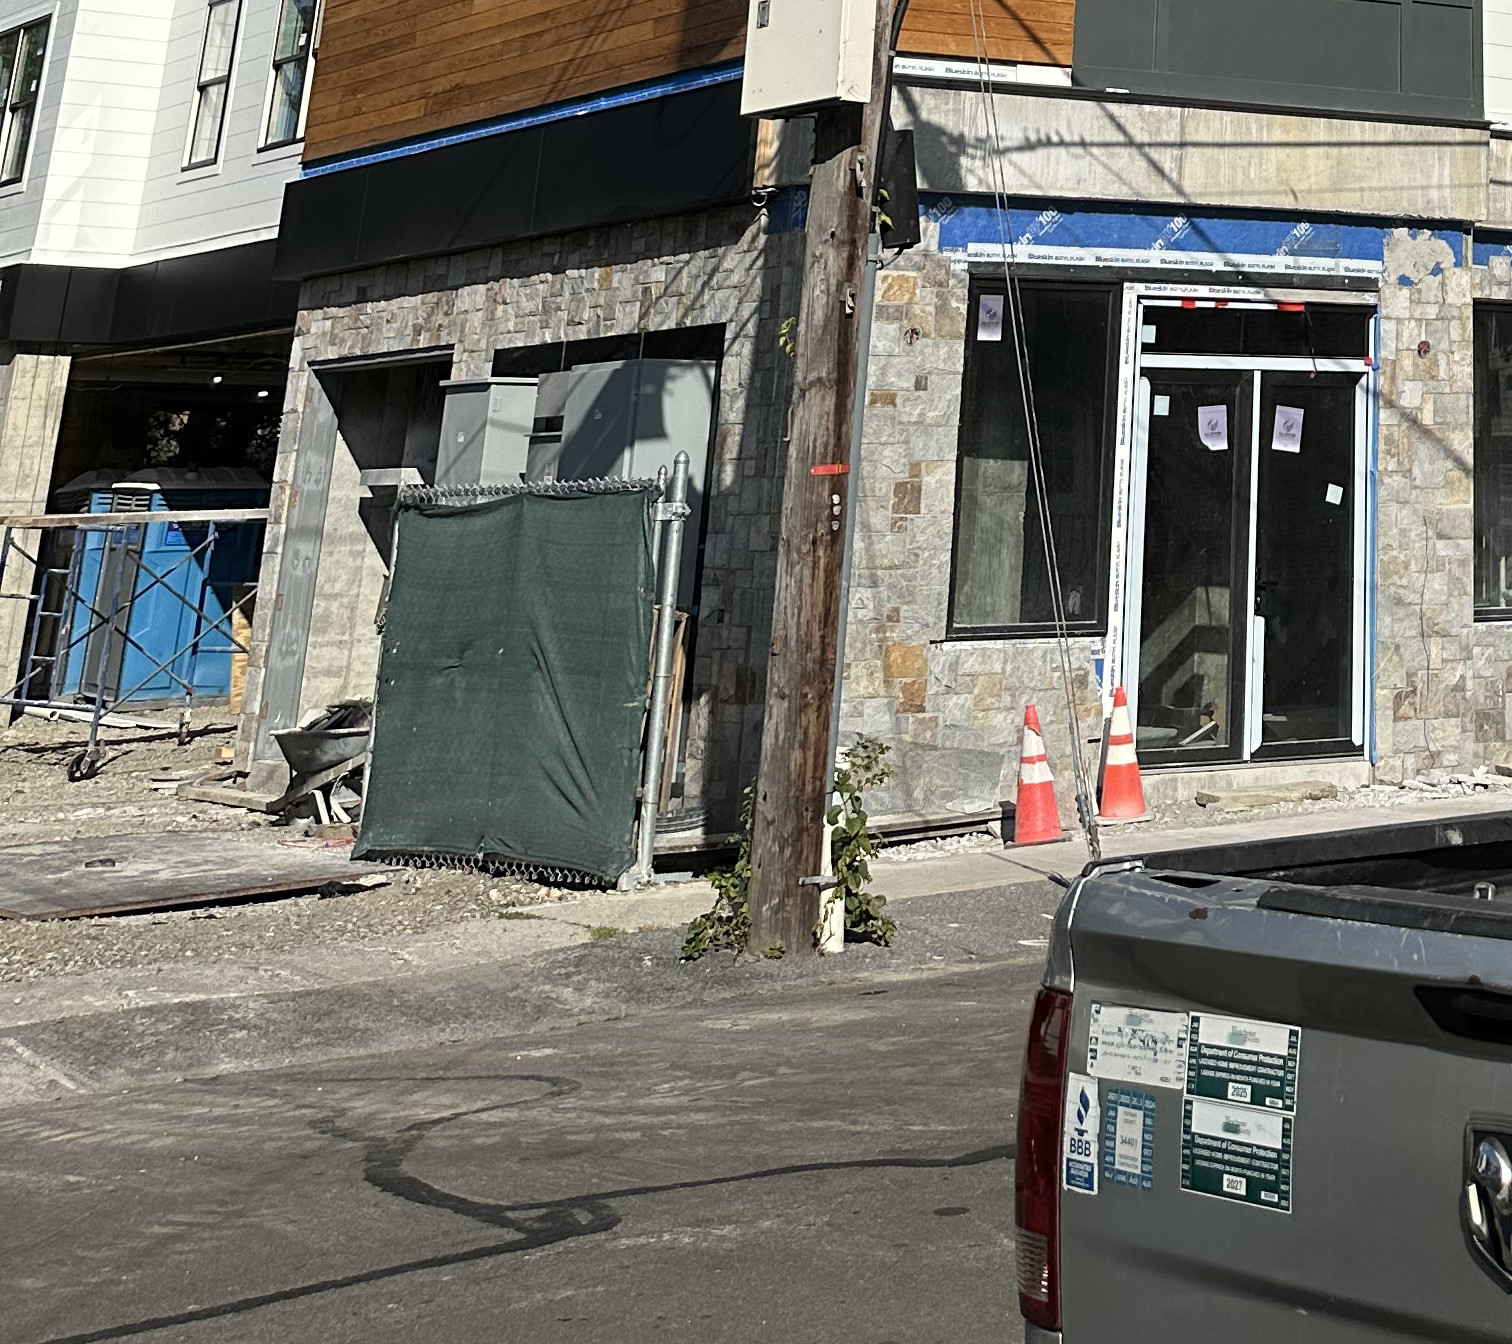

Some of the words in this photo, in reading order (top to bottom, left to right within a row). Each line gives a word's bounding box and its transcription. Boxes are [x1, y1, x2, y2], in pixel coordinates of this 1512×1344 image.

[1231, 1085, 1248, 1098] 2025
[1070, 1137, 1091, 1157] BBB
[1226, 1177, 1243, 1192] 2027
